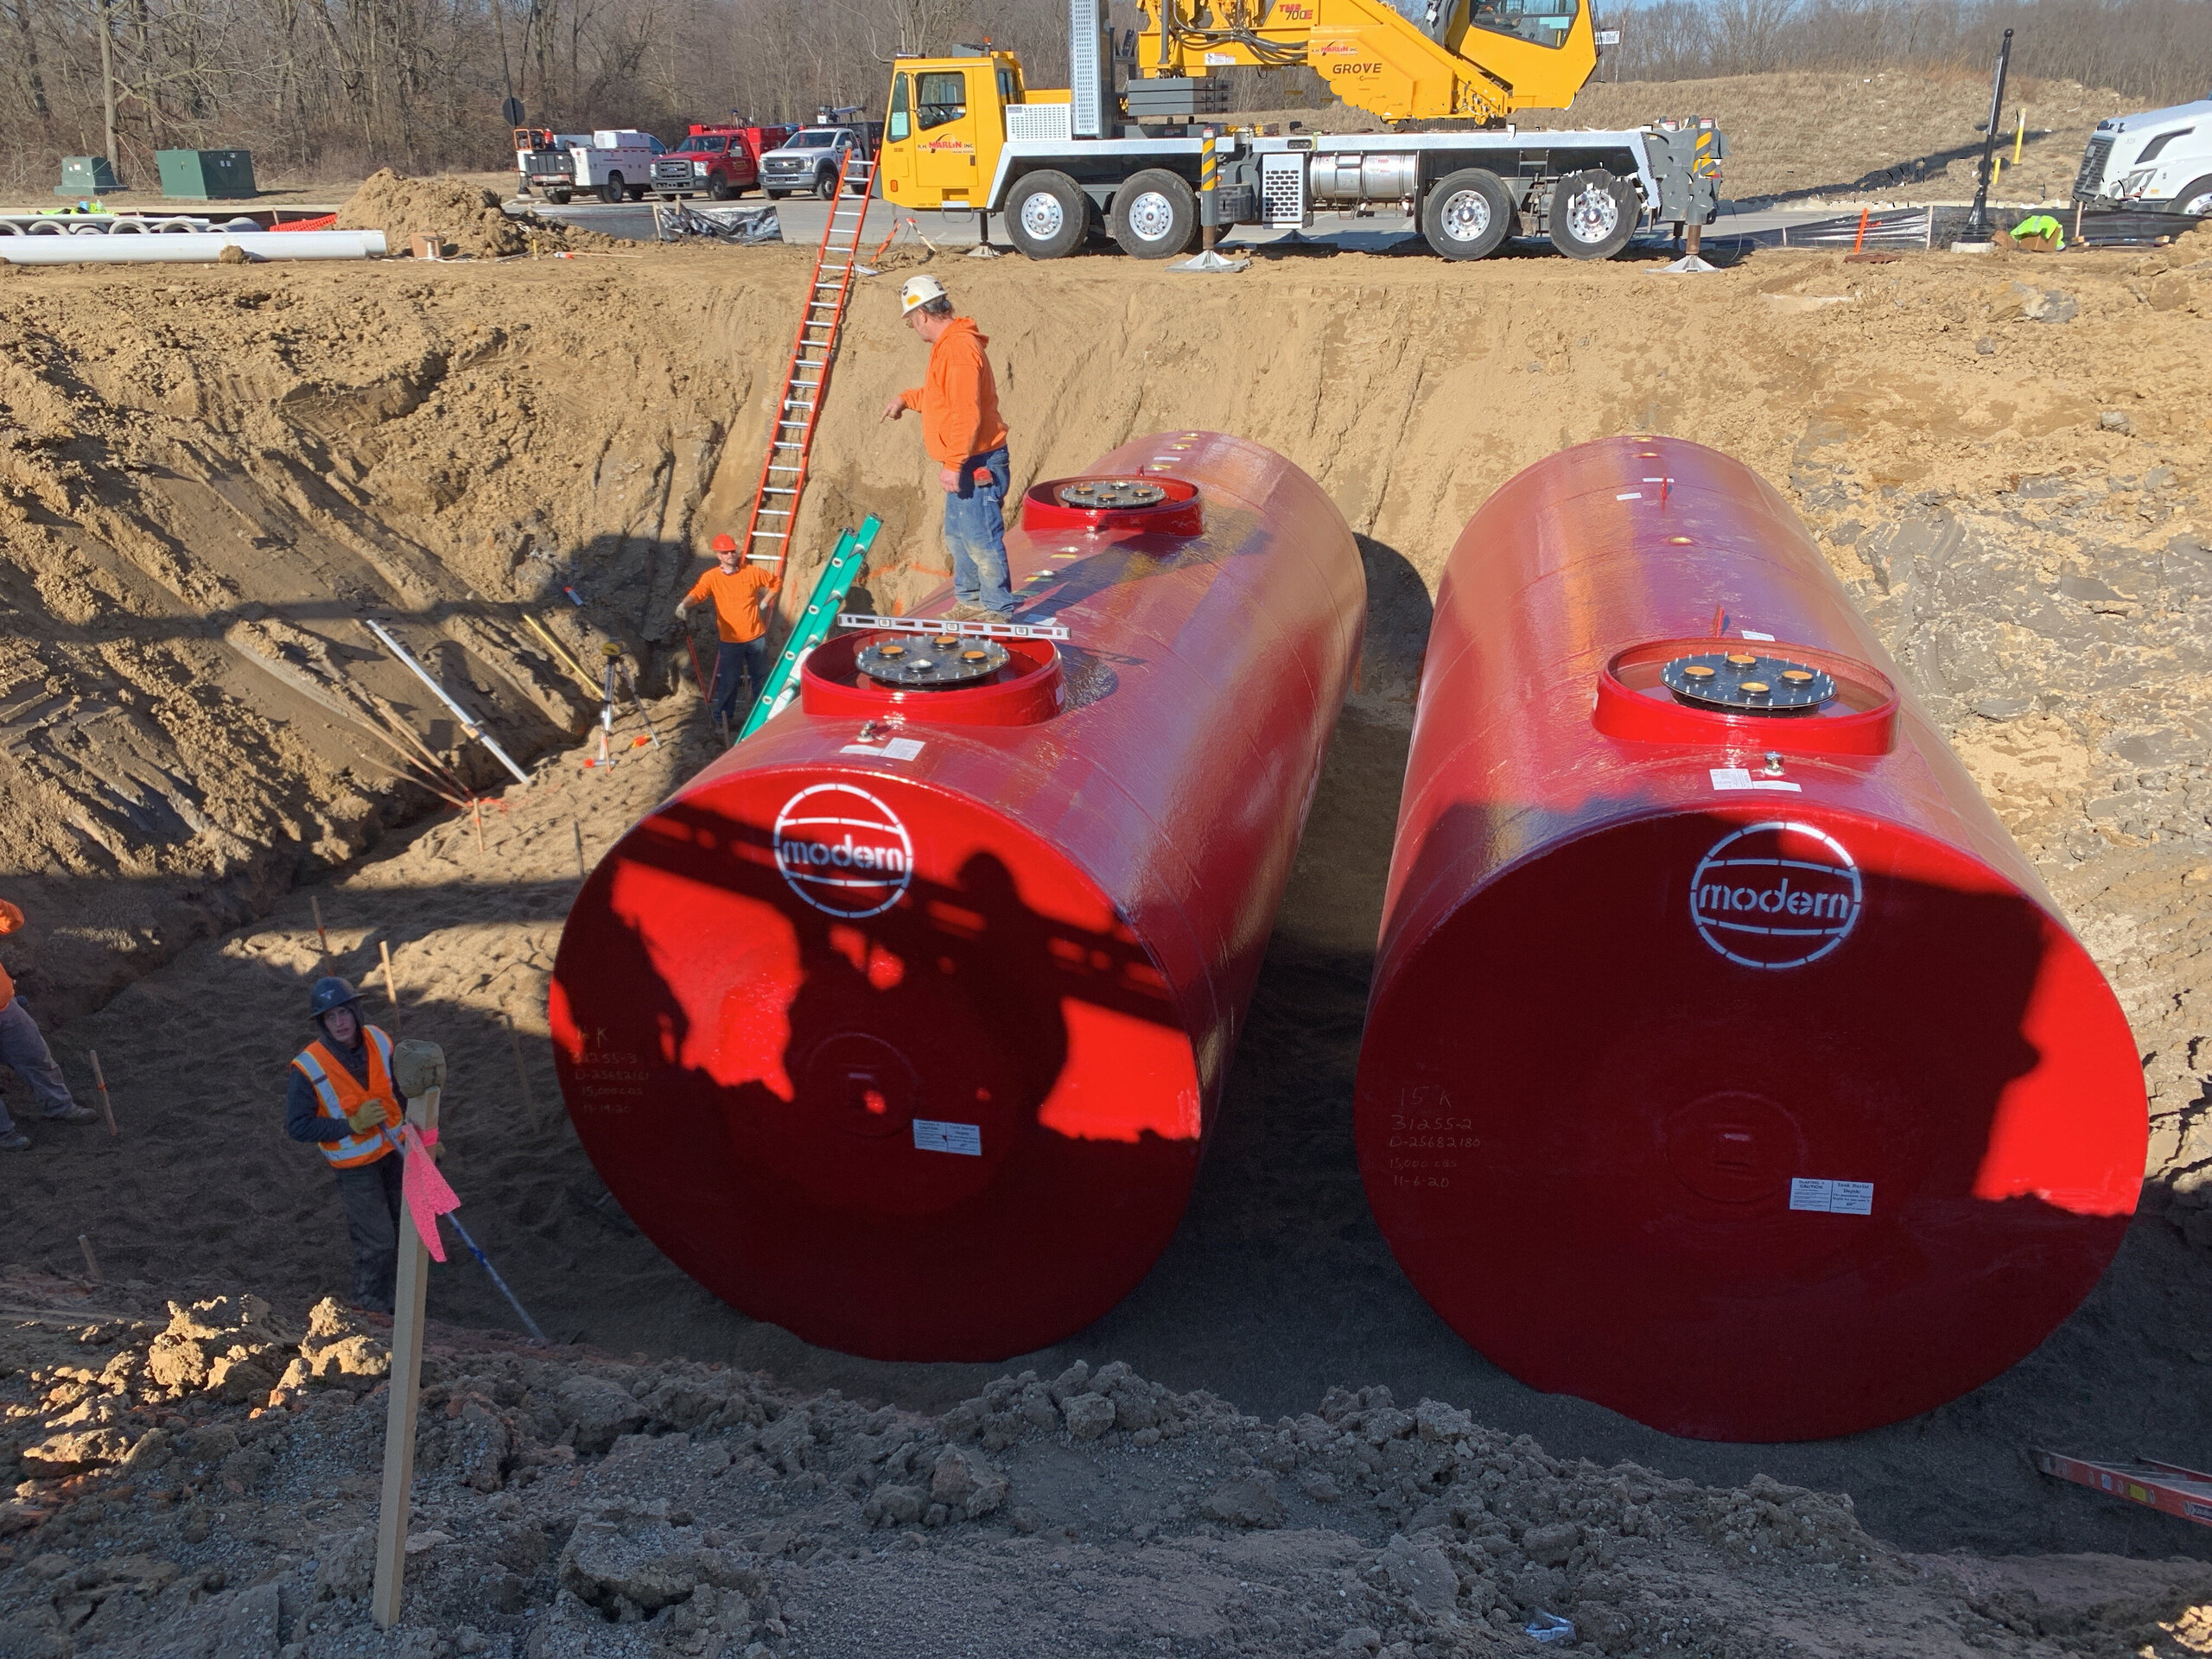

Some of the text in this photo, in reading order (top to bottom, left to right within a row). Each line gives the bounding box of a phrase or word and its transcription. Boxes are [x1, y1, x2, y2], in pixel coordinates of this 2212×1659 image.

[1332, 63, 1382, 74] GROVE
[782, 834, 905, 871] modern
[1700, 878, 1849, 918] modern
[1390, 1114, 1473, 1131] 31255-2
